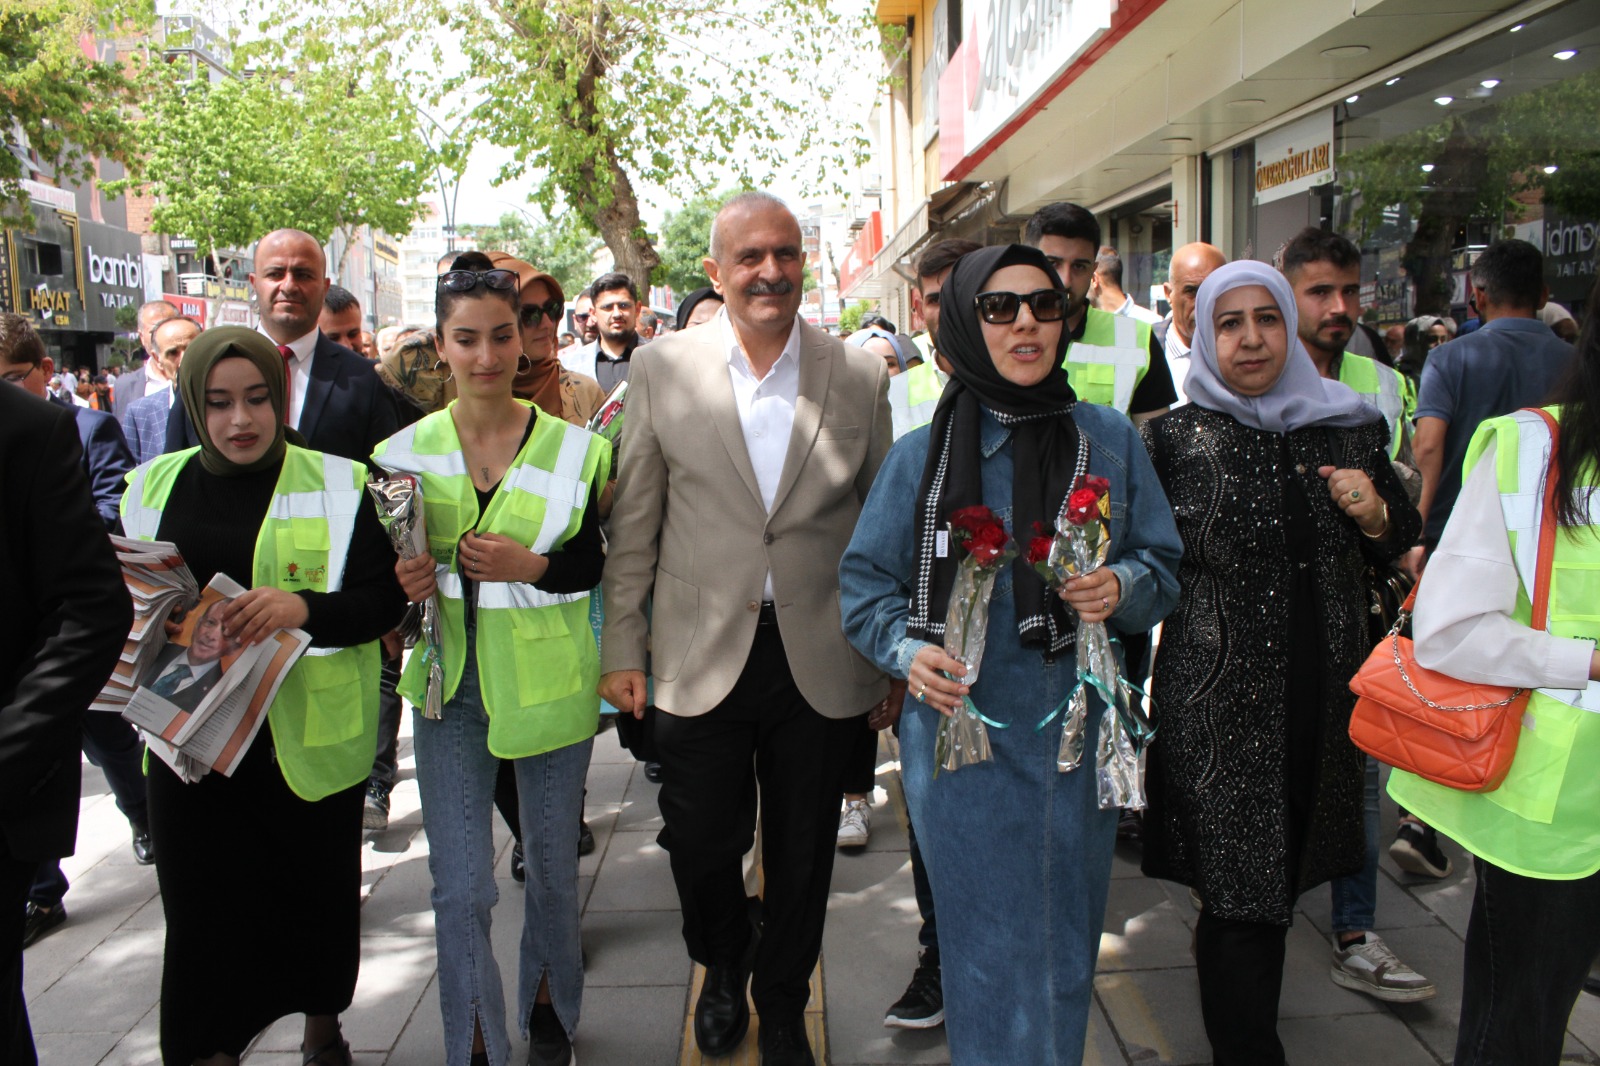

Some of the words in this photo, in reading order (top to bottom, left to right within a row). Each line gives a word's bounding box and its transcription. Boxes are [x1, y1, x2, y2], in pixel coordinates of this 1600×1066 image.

[1256, 142, 1330, 192] ÖMEROĞULLARI
[87, 246, 143, 289] bambi
[30, 287, 71, 312] HAYAT
